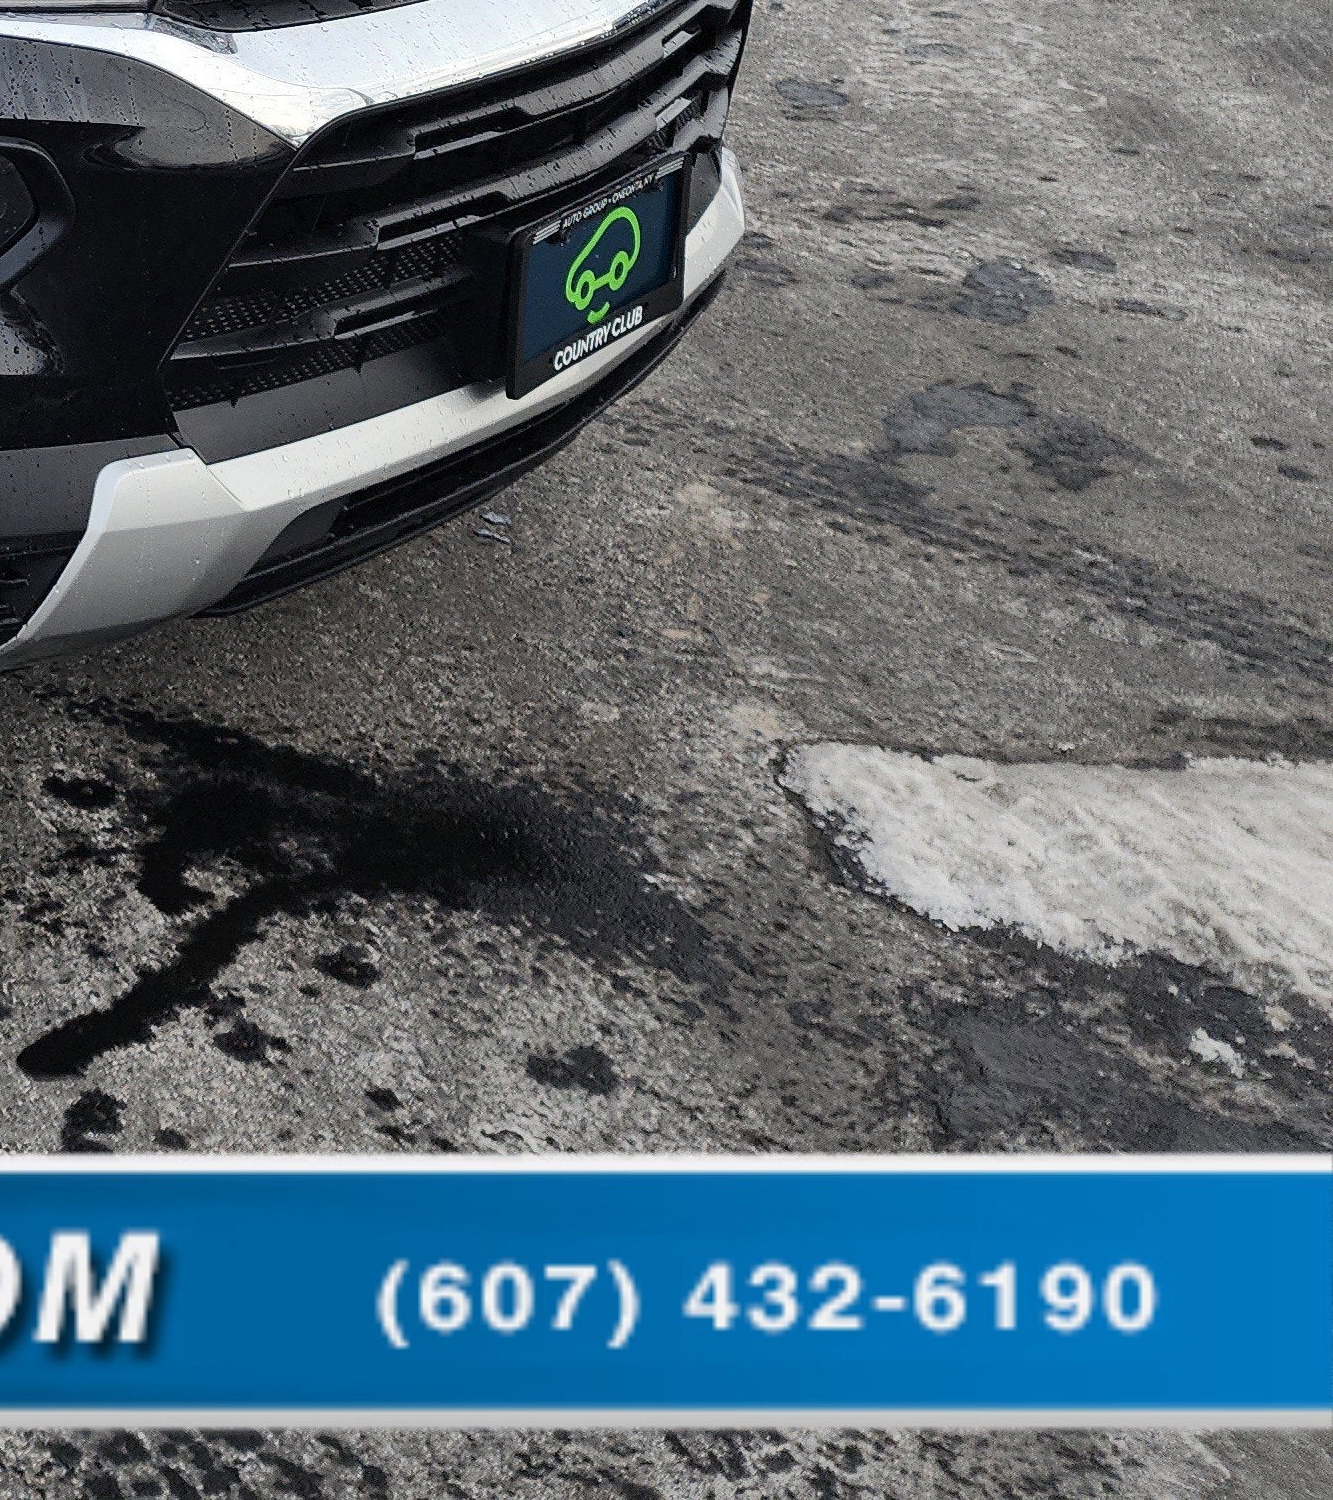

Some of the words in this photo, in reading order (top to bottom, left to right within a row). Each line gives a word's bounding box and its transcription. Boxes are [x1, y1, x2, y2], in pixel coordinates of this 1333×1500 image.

[562, 210, 582, 229] AUTO
[554, 322, 612, 371] COUNTRY
[611, 305, 643, 337] CLUB
